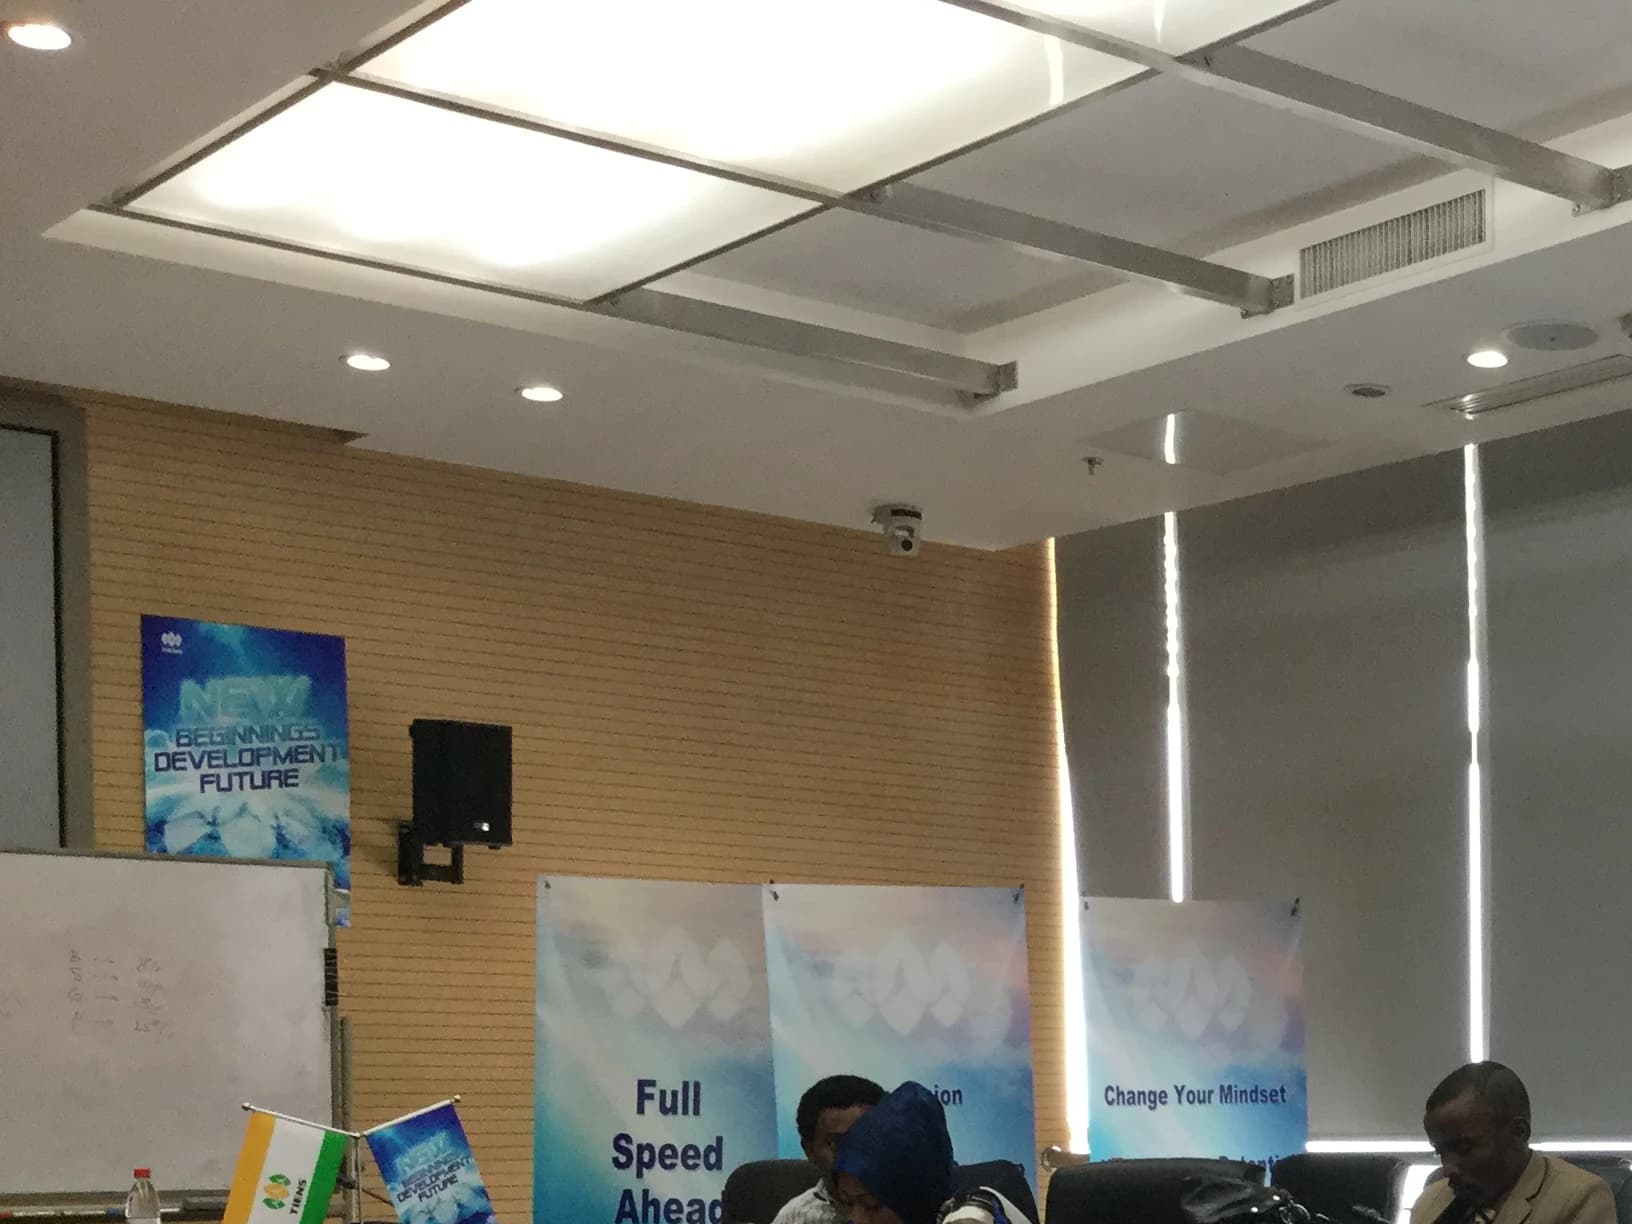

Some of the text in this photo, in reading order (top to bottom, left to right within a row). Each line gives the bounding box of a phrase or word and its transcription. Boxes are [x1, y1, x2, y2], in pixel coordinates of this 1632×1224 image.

[179, 674, 313, 725] NEW
[176, 721, 320, 748] BEGINNINGS
[154, 743, 338, 772] DEVELOPMENT
[200, 768, 299, 793] FUTURE
[636, 1079, 701, 1117] Full
[1104, 1084, 1287, 1110] Change Your Mindset
[612, 1132, 724, 1179] Speed
[289, 1178, 307, 1215] TIENS
